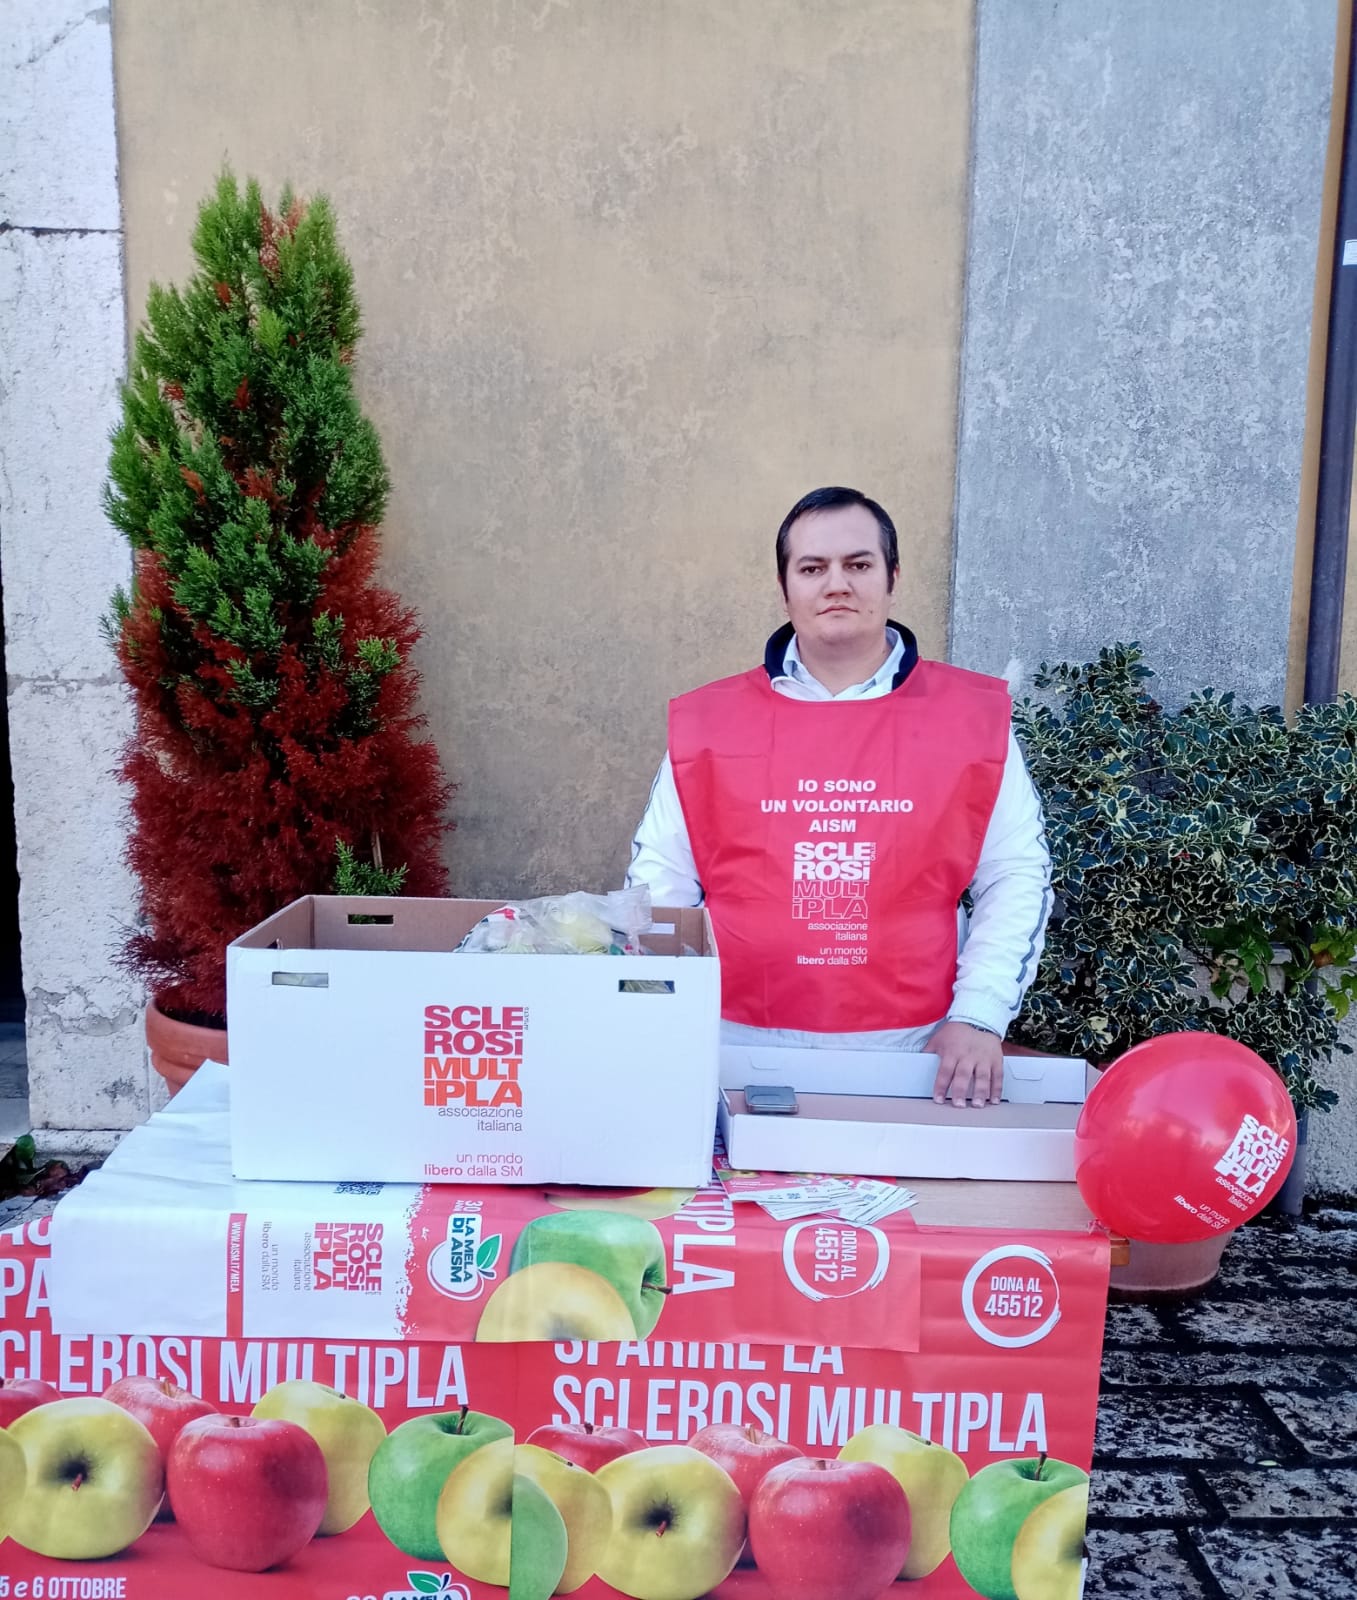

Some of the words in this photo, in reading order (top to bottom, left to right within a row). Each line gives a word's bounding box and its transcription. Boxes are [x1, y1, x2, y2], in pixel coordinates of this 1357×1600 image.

[798, 779, 818, 792] IO
[824, 779, 876, 793] SONO
[760, 799, 786, 812] UN
[792, 799, 914, 813] VOLONTARIO
[808, 819, 856, 833] AISM
[794, 841, 871, 861] SCLE
[793, 860, 871, 881] ROSi
[792, 879, 870, 899] MULT
[791, 897, 868, 920] iPLA
[807, 921, 868, 931] associazione
[835, 931, 867, 941] italiana
[796, 955, 825, 965] libero
[827, 955, 849, 966] dalla
[851, 955, 868, 965] SM
[820, 947, 832, 955] un
[834, 946, 867, 955] mondo
[424, 1005, 524, 1030] SCLE
[424, 1030, 524, 1056] ROSi
[424, 1057, 523, 1081] MULT
[424, 1080, 523, 1107] iPLA
[438, 1106, 523, 1118] associazione
[477, 1119, 523, 1132] italiana
[1243, 1114, 1290, 1157] SCLE
[456, 1153, 473, 1164] un
[476, 1152, 523, 1164] mondo
[1222, 1142, 1276, 1182] MULT
[424, 1164, 463, 1176] libero
[467, 1164, 497, 1177] dalla
[501, 1165, 524, 1177] SM
[463, 1200, 483, 1212] 30
[1174, 1194, 1198, 1214] libero
[1200, 1203, 1211, 1213] un
[261, 1221, 272, 1249] libero
[452, 1217, 465, 1233] DI
[465, 1217, 476, 1237] LA
[271, 1244, 279, 1256] un
[814, 1227, 838, 1282] 45512
[841, 1230, 857, 1262] DONA
[261, 1251, 271, 1272] dalla
[303, 1231, 311, 1291] associazione
[313, 1223, 334, 1291] iPLA
[333, 1223, 350, 1291] MULT
[348, 1223, 367, 1291] ROSi
[365, 1223, 384, 1291] SCLE
[450, 1237, 464, 1283] AISM
[463, 1239, 474, 1282] MELA
[271, 1258, 280, 1291] mondo
[840, 1263, 857, 1280] AL
[991, 1276, 1024, 1292] DONA
[1026, 1277, 1043, 1293] AL
[984, 1294, 1043, 1318] 45512
[552, 1375, 792, 1444] SCLEROSI
[14, 1579, 29, 1598] e
[32, 1576, 44, 1598] 6
[48, 1577, 127, 1600] OTTOBRE
